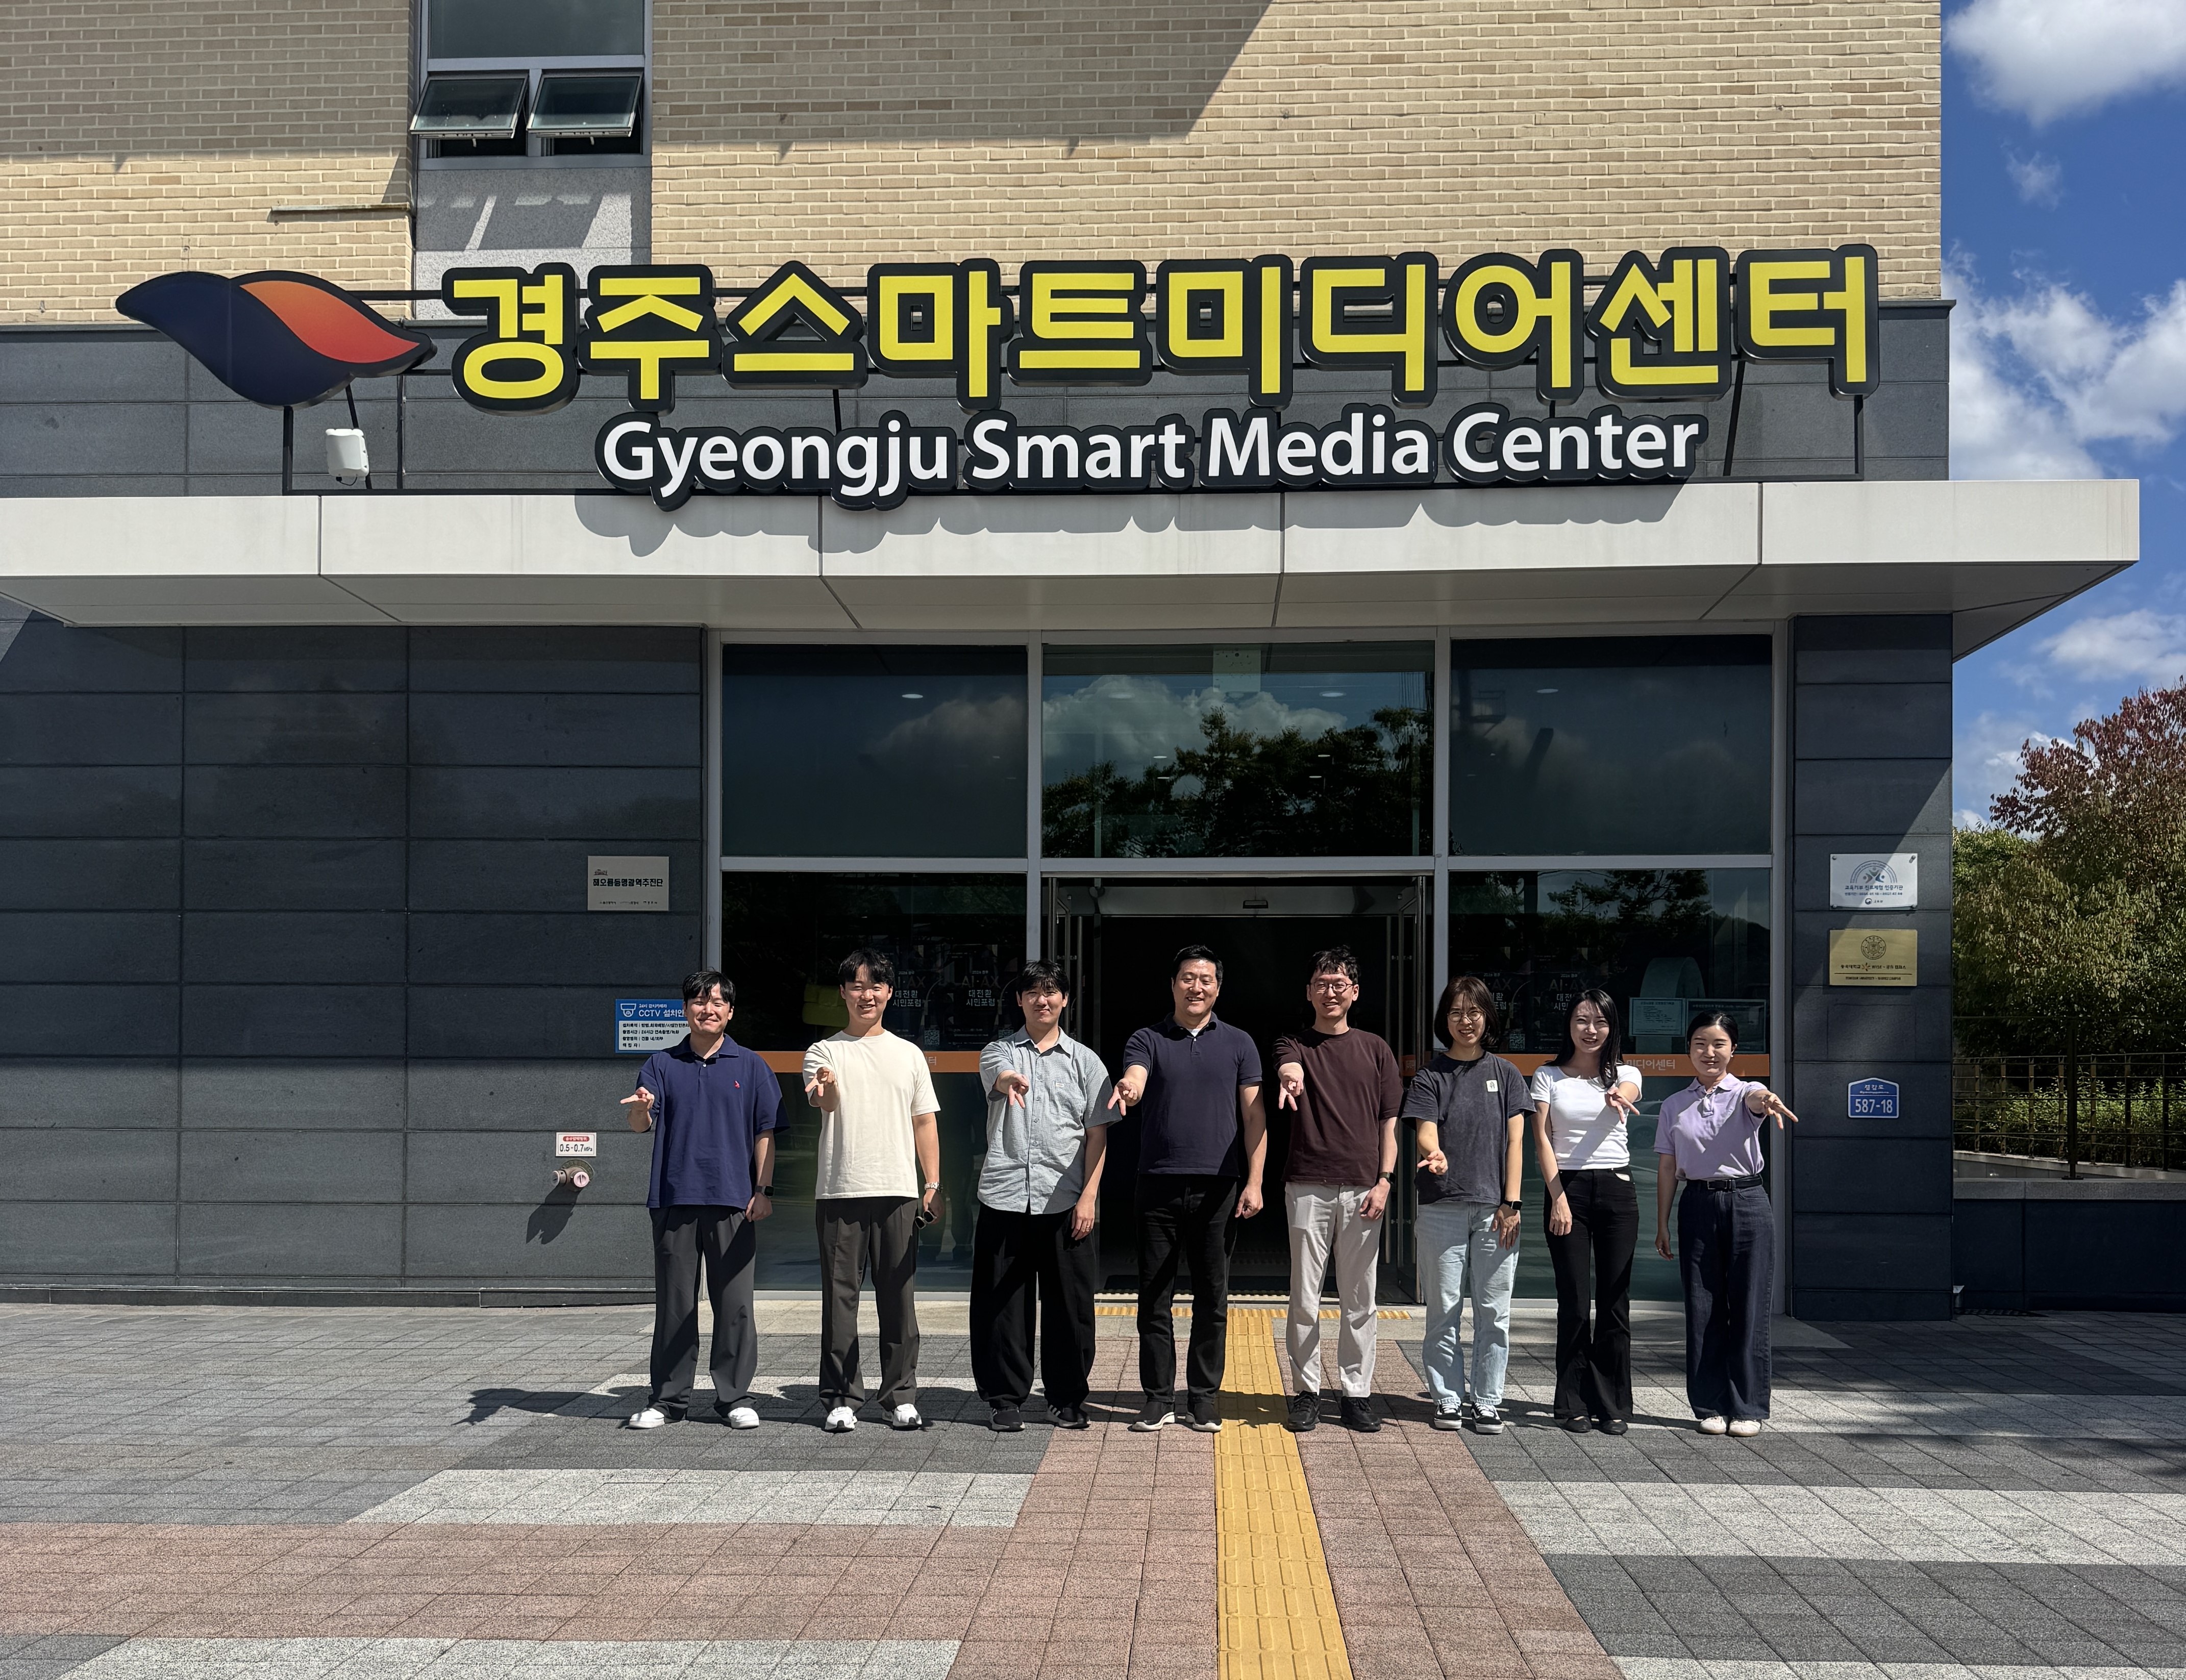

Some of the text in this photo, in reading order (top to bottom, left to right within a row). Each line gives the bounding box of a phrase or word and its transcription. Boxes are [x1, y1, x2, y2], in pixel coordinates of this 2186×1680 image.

[454, 256, 1865, 399] 경주스마트미디어센터
[604, 412, 1699, 498] Gyeongju Smart Media Center
[895, 990, 918, 998] 대전환
[968, 989, 992, 998] 대전환
[1557, 993, 1574, 1002] 대전
[966, 998, 996, 1007] 시민포럼
[1554, 1002, 1569, 1011] 시민
[663, 1009, 684, 1018] 설치안
[1855, 1098, 1893, 1113] 587-18
